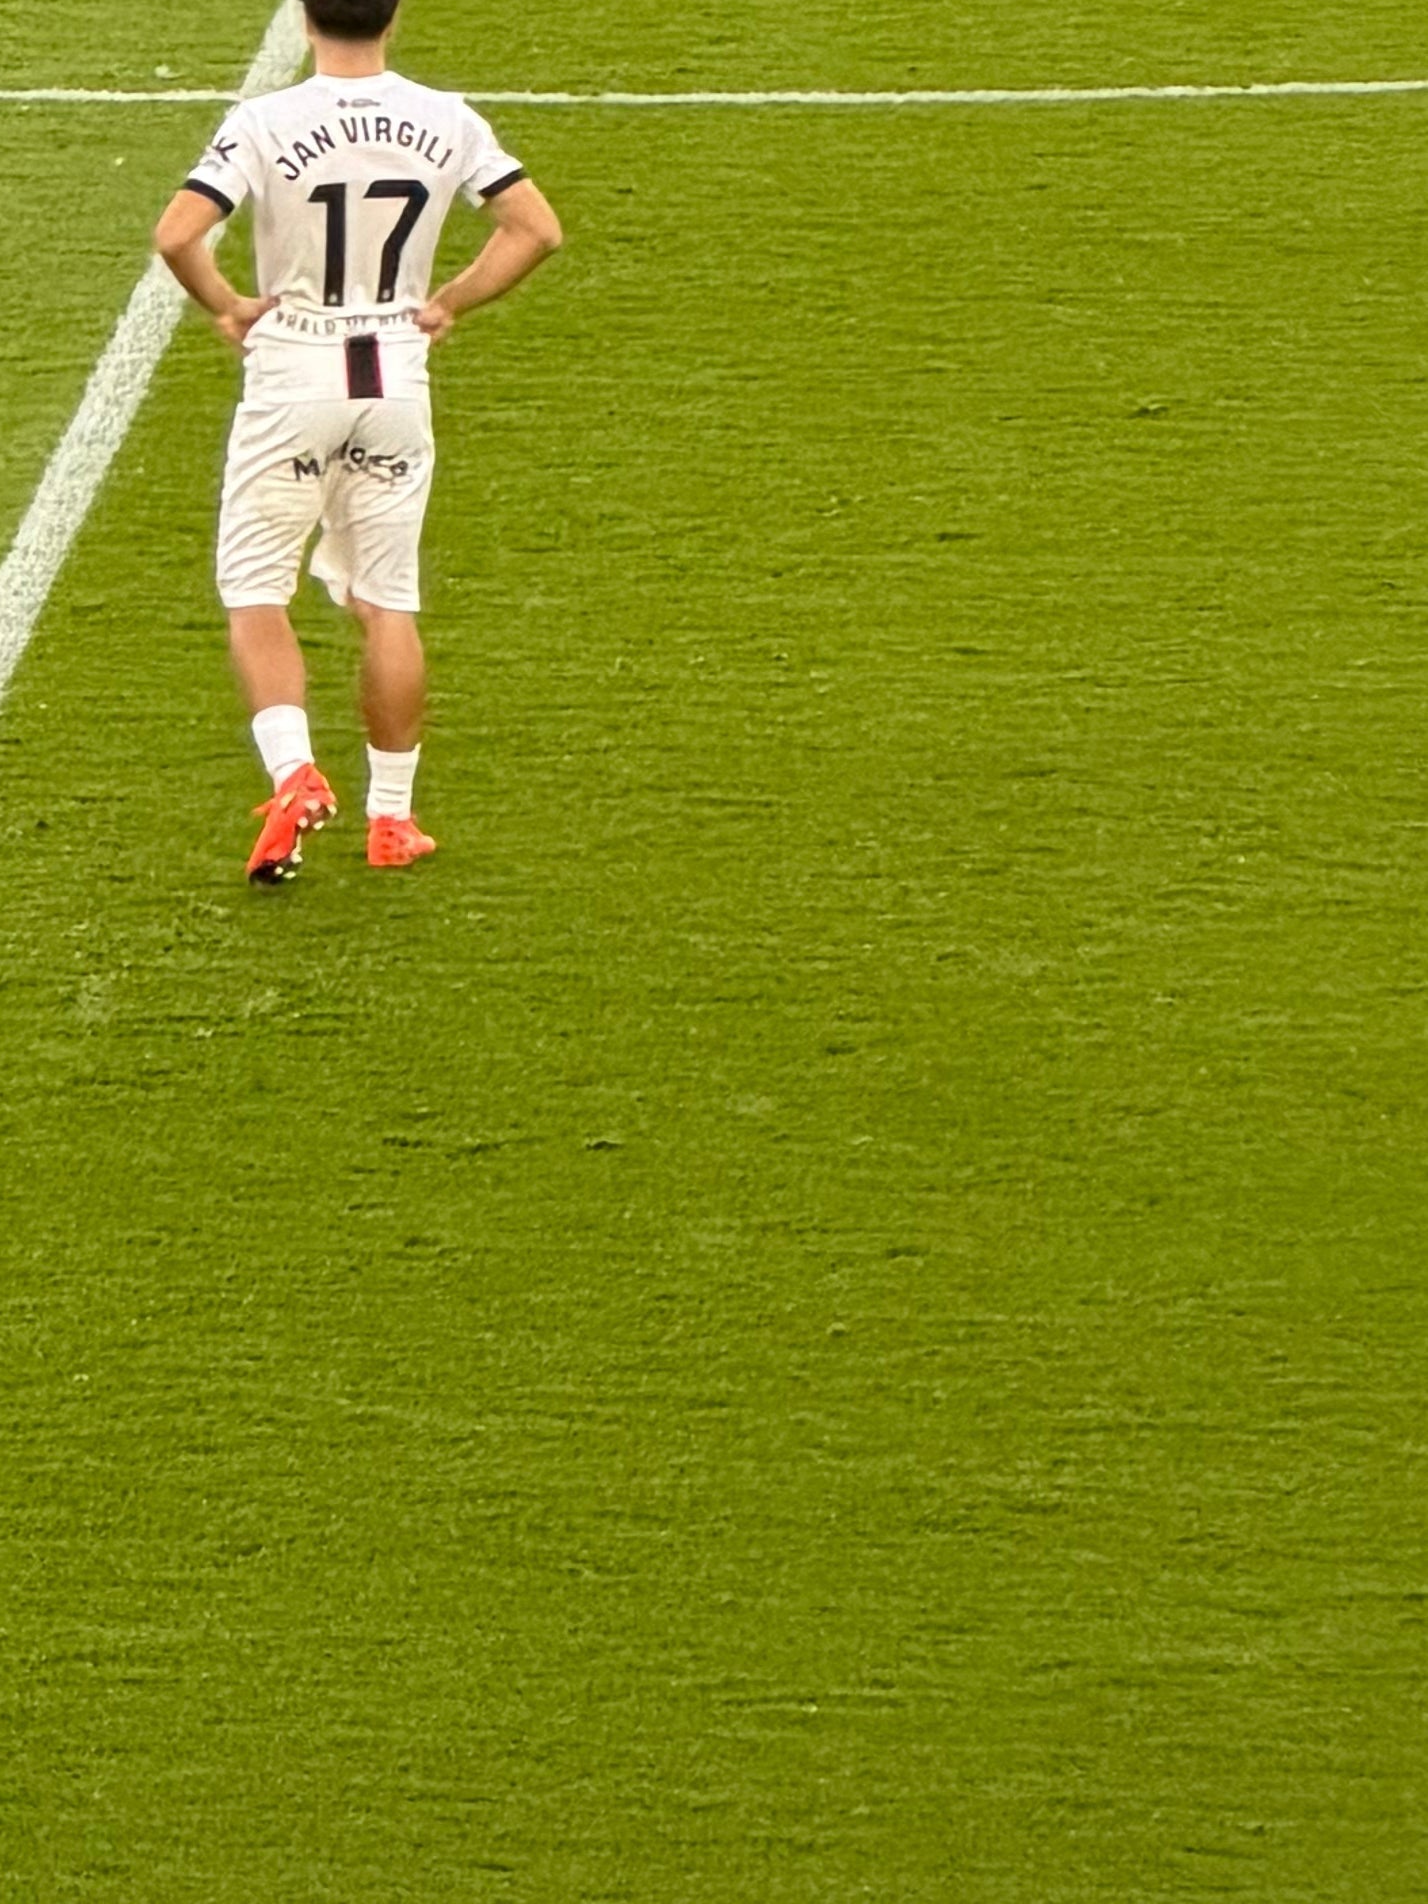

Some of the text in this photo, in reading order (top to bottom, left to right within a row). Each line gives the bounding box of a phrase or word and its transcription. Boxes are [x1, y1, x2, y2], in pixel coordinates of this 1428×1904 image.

[275, 115, 454, 182] JAN VIRGILI
[306, 179, 431, 307] 17
